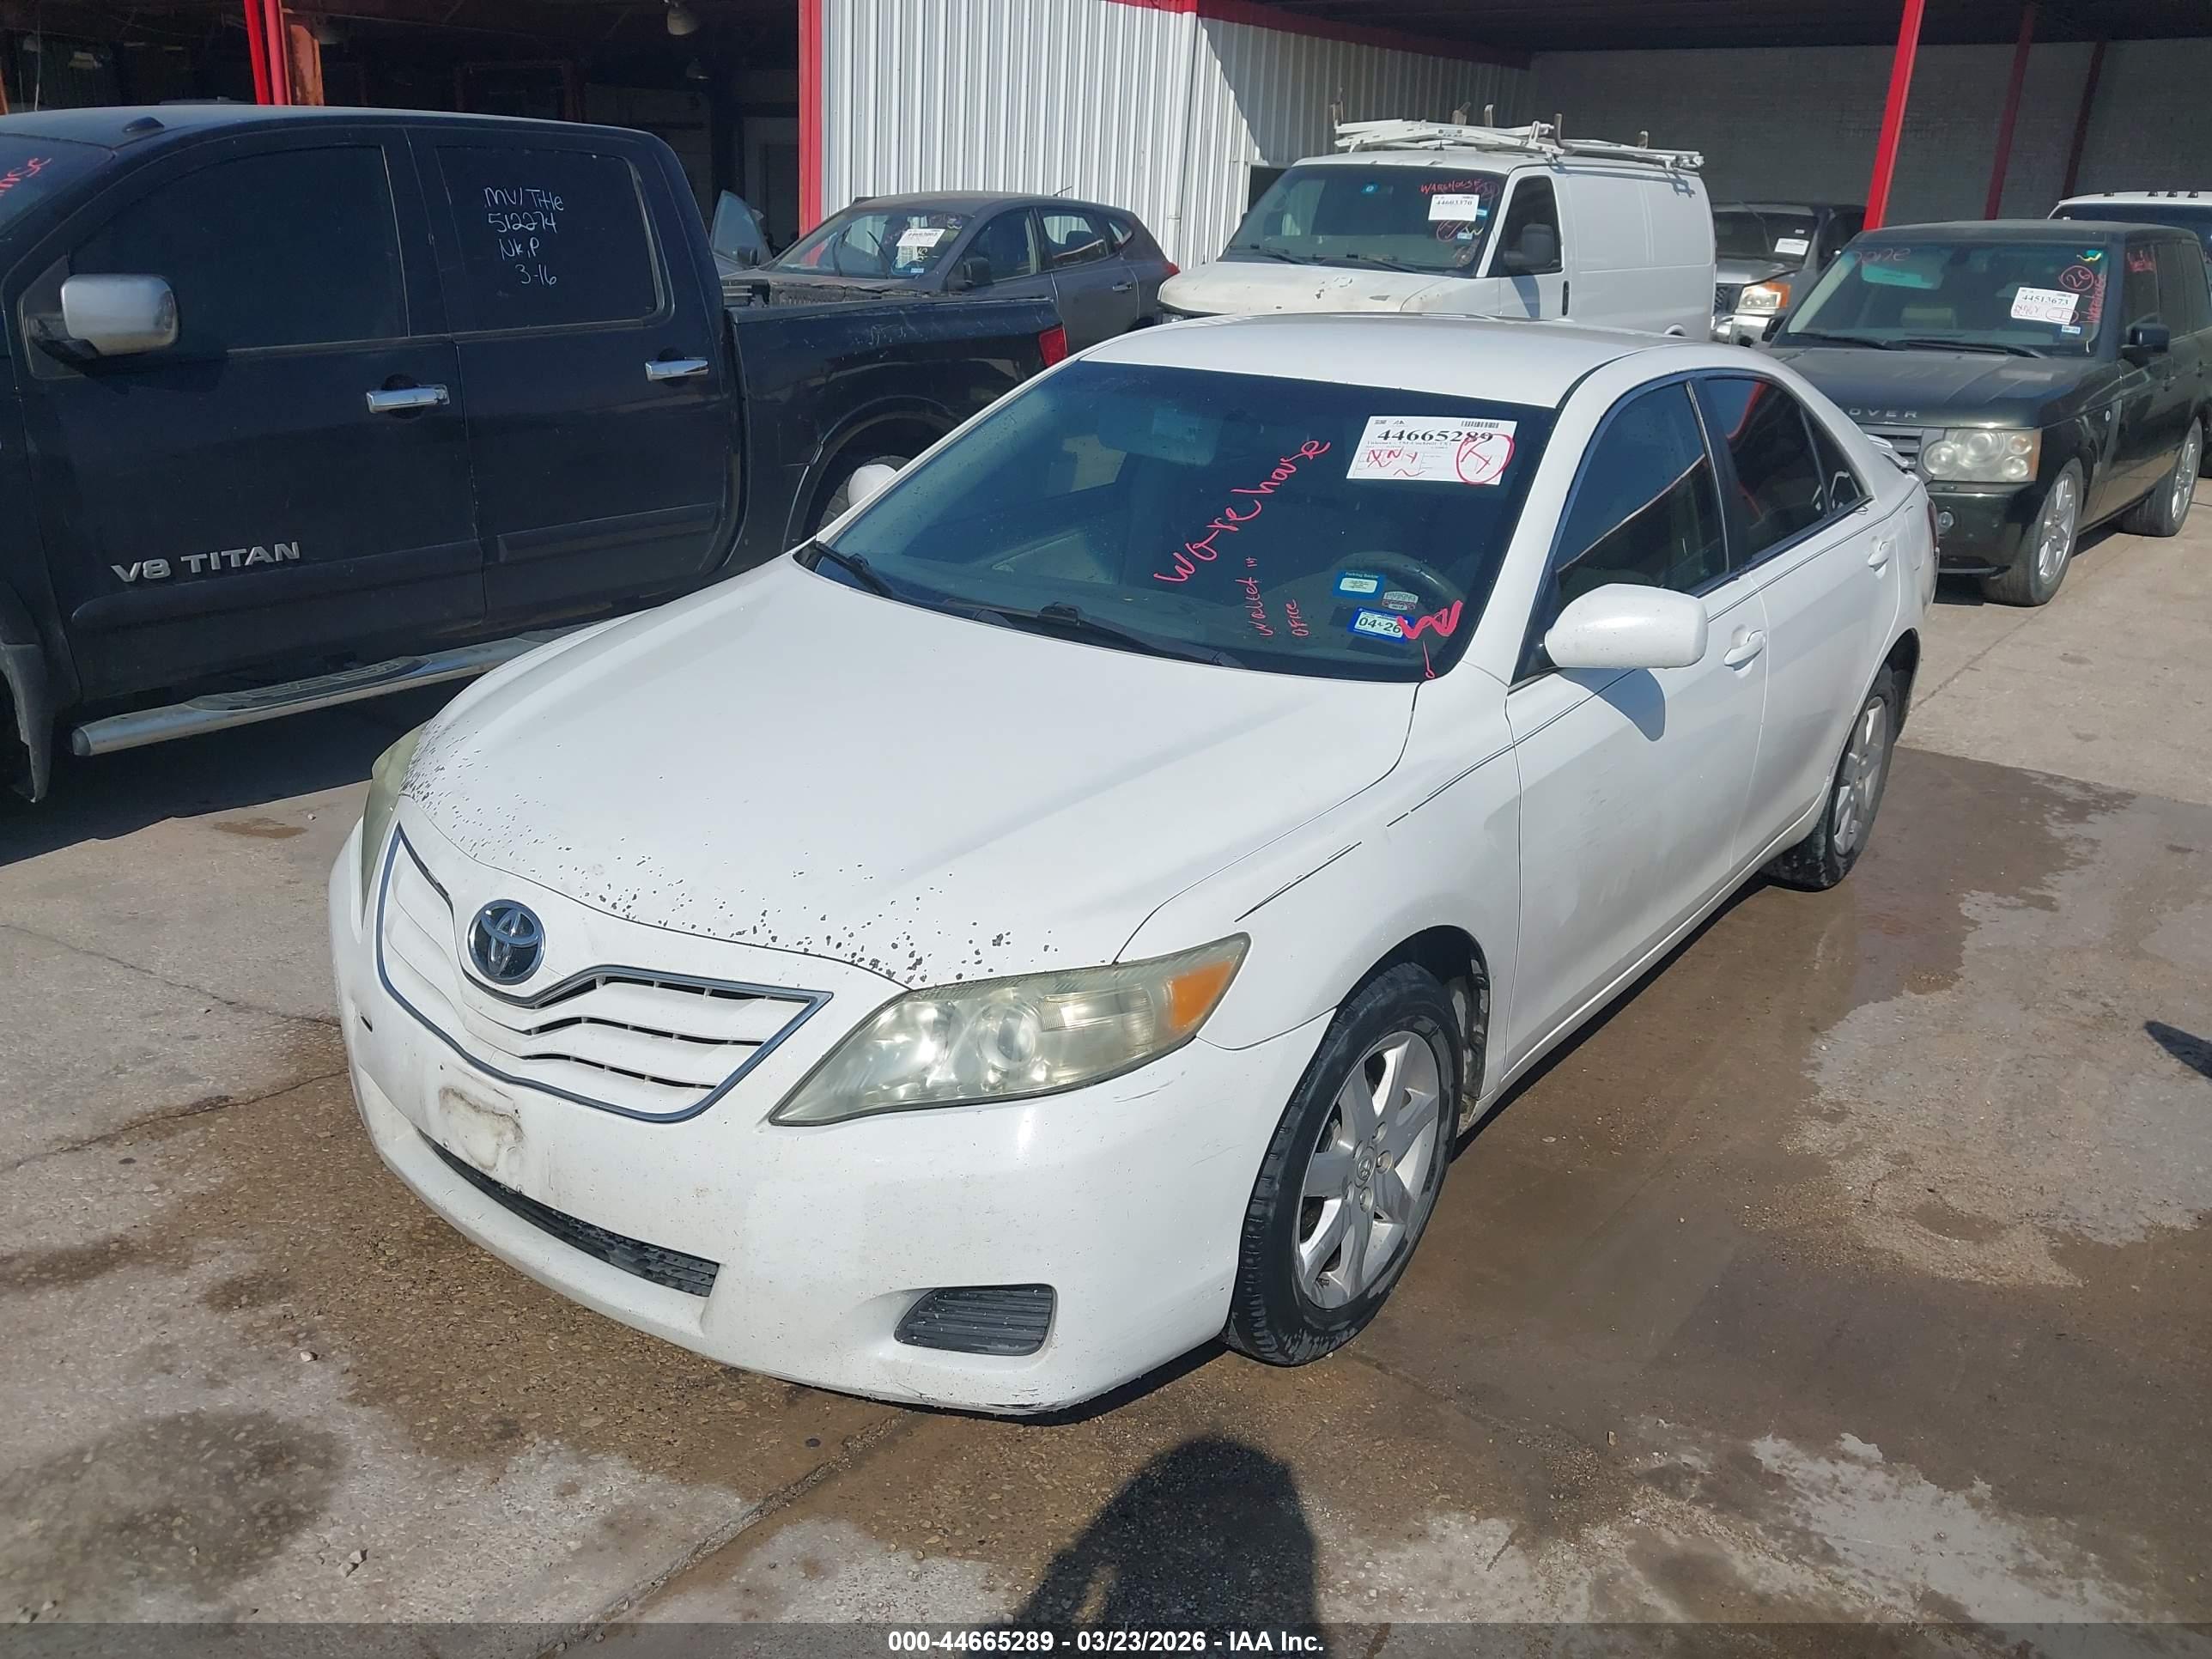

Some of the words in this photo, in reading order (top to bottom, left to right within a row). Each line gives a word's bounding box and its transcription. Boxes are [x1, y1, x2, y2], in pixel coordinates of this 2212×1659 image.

[515, 263, 557, 285] 3-16
[1377, 428, 1494, 446] 44665289
[111, 558, 172, 583] V8
[180, 541, 301, 574] TITAN
